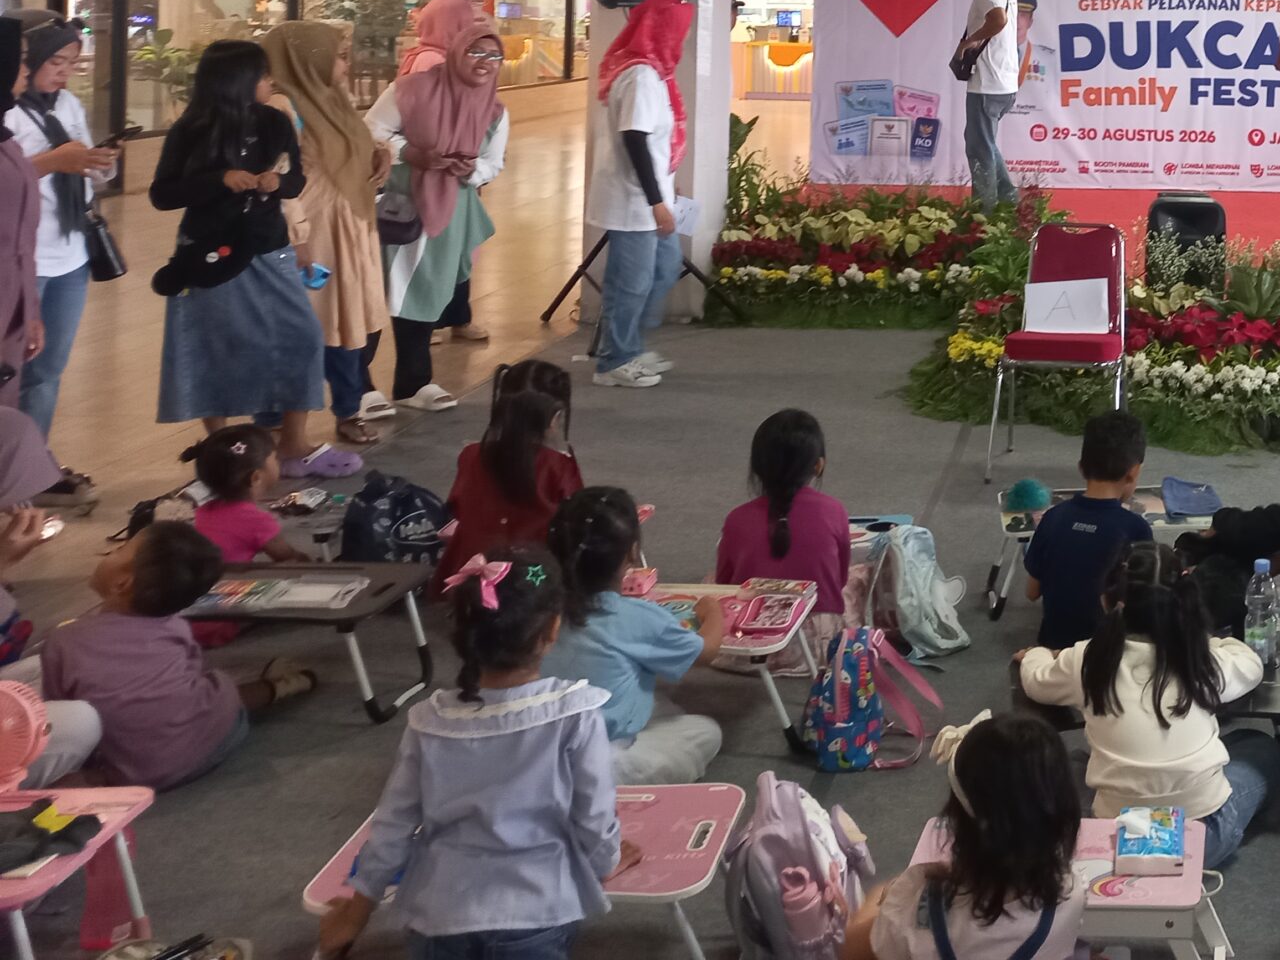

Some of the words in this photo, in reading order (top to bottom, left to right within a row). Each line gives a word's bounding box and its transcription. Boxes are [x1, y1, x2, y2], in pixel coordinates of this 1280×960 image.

[1060, 77, 1178, 112] Family
[914, 137, 932, 148] IKD
[1052, 127, 1097, 141] 29-30
[1102, 129, 1174, 143] AGUSTUS
[1179, 130, 1216, 143] 2026
[1045, 290, 1076, 322] A
